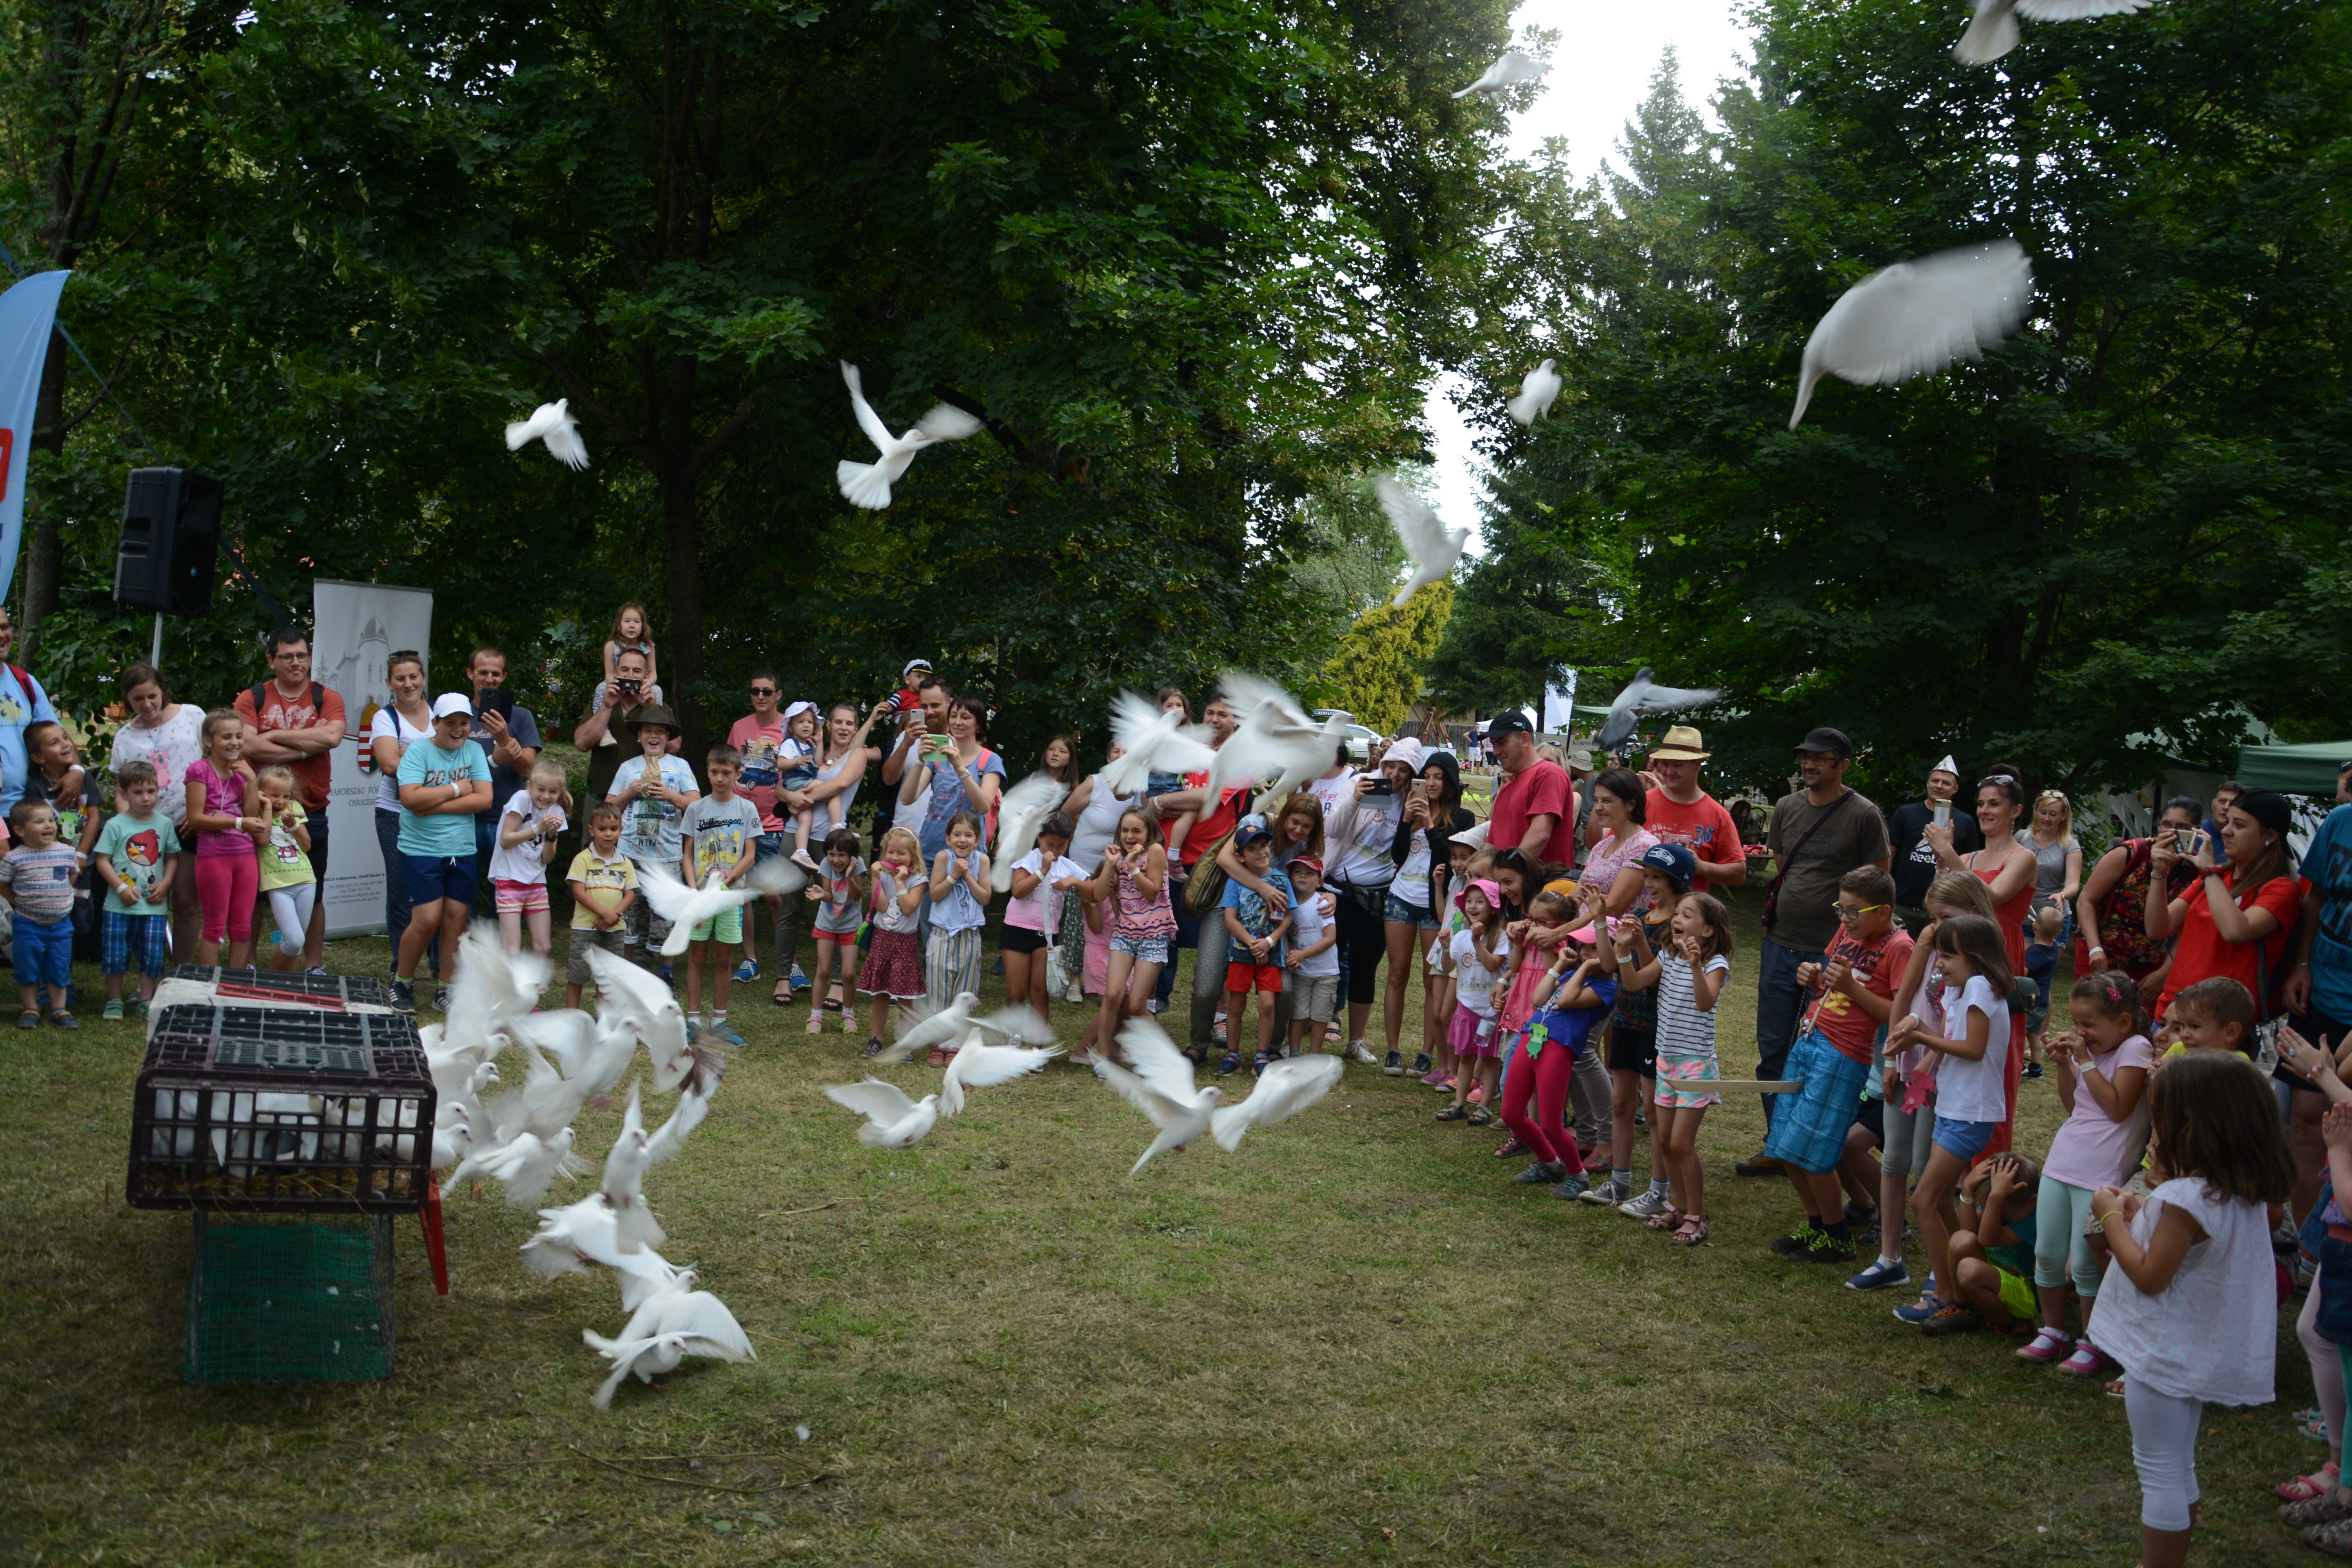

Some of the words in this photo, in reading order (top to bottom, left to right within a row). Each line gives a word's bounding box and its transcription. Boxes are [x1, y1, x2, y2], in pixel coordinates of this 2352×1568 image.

[425, 769, 445, 786] DO
[448, 765, 471, 784] NOT
[328, 786, 365, 796] YARORSZÁG
[697, 817, 744, 828] Volkswagen
[1693, 826, 1715, 845] 36
[639, 838, 656, 846] PALM
